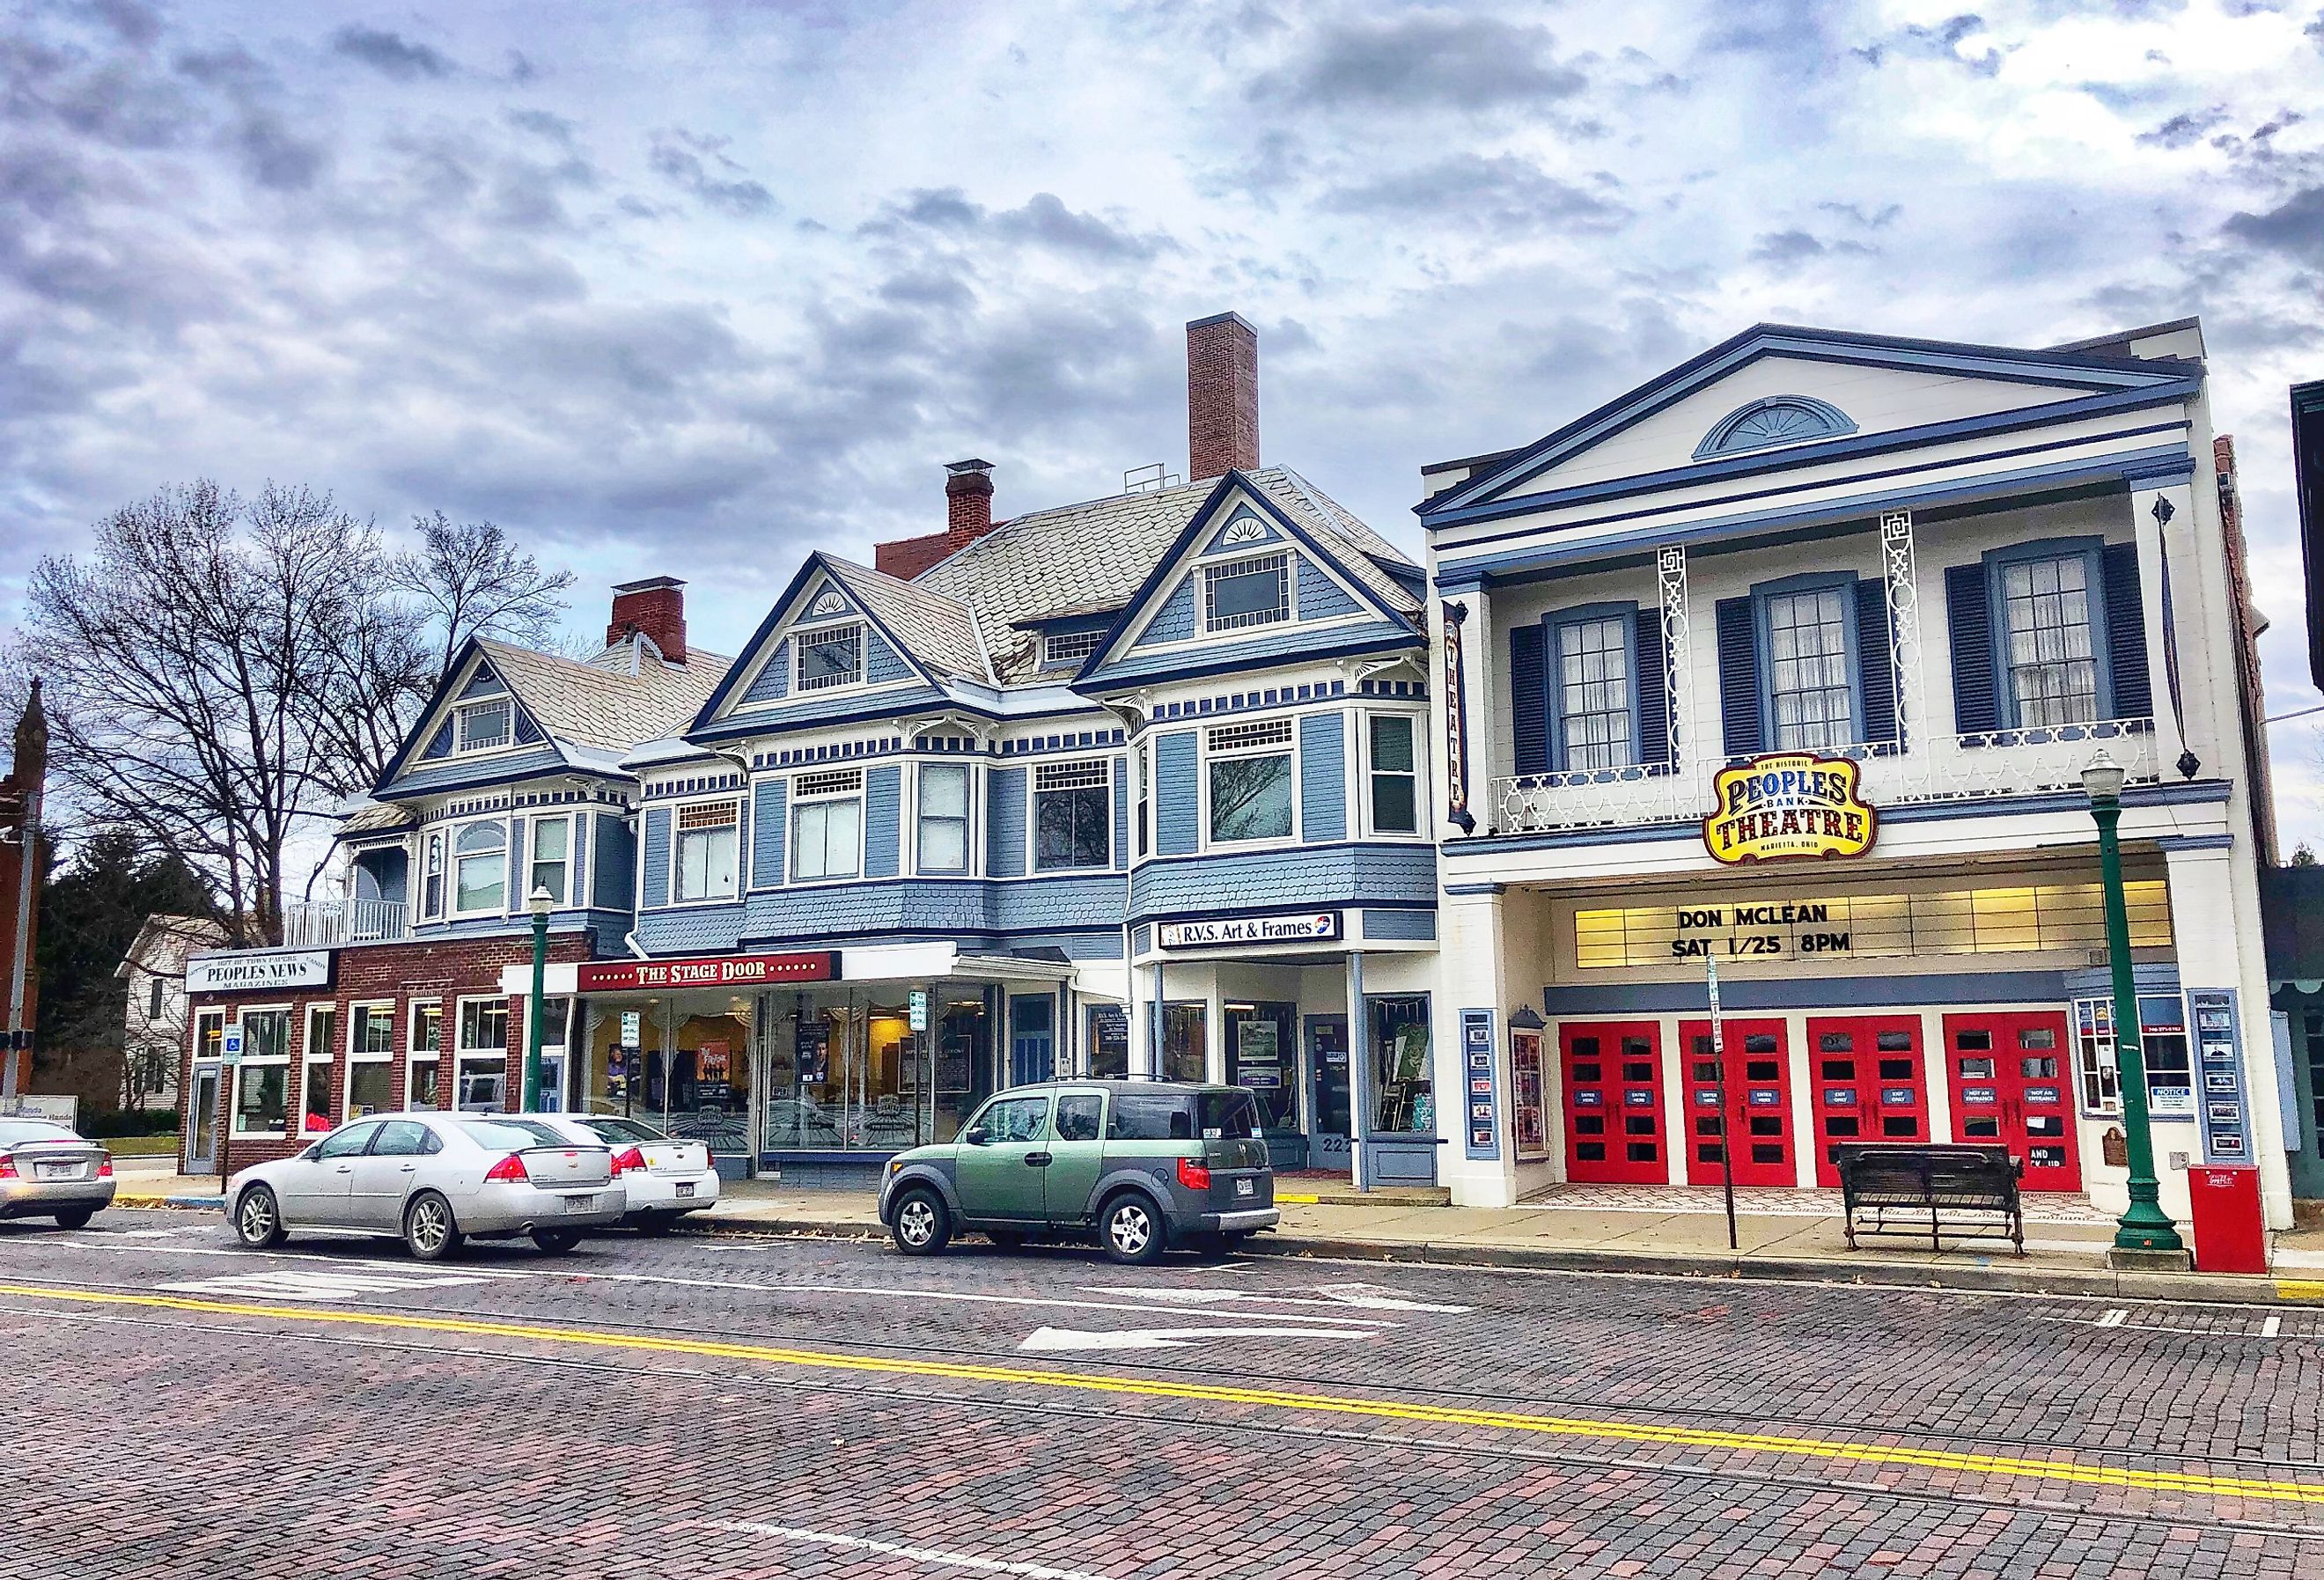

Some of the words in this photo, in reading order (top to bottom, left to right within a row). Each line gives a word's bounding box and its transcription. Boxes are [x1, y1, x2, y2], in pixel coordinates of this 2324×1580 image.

[1447, 644, 1460, 802] THEATRE
[1776, 760, 1808, 768] HISTORIC
[1726, 770, 1848, 816] PEOPLES
[1766, 797, 1806, 808] BANK
[1716, 808, 1864, 851] THEATRE
[1679, 909, 1723, 929] DON
[1735, 904, 1828, 925] MCLEAN
[1183, 923, 1218, 942] R.V.S.
[1222, 922, 1243, 939] Art
[1247, 922, 1258, 937] &
[1262, 921, 1313, 937] Frames
[1672, 938, 1712, 957] SAT
[1729, 936, 1782, 955] 1/25
[1800, 932, 1850, 952] 8PM
[207, 966, 266, 981] PEOPLES
[269, 961, 307, 978] NEWS
[636, 966, 667, 985] THE
[670, 963, 717, 983] STAGE
[721, 960, 766, 981] DOOR
[223, 979, 289, 988] MAGAZINES
[2030, 1149, 2048, 1159] AND
